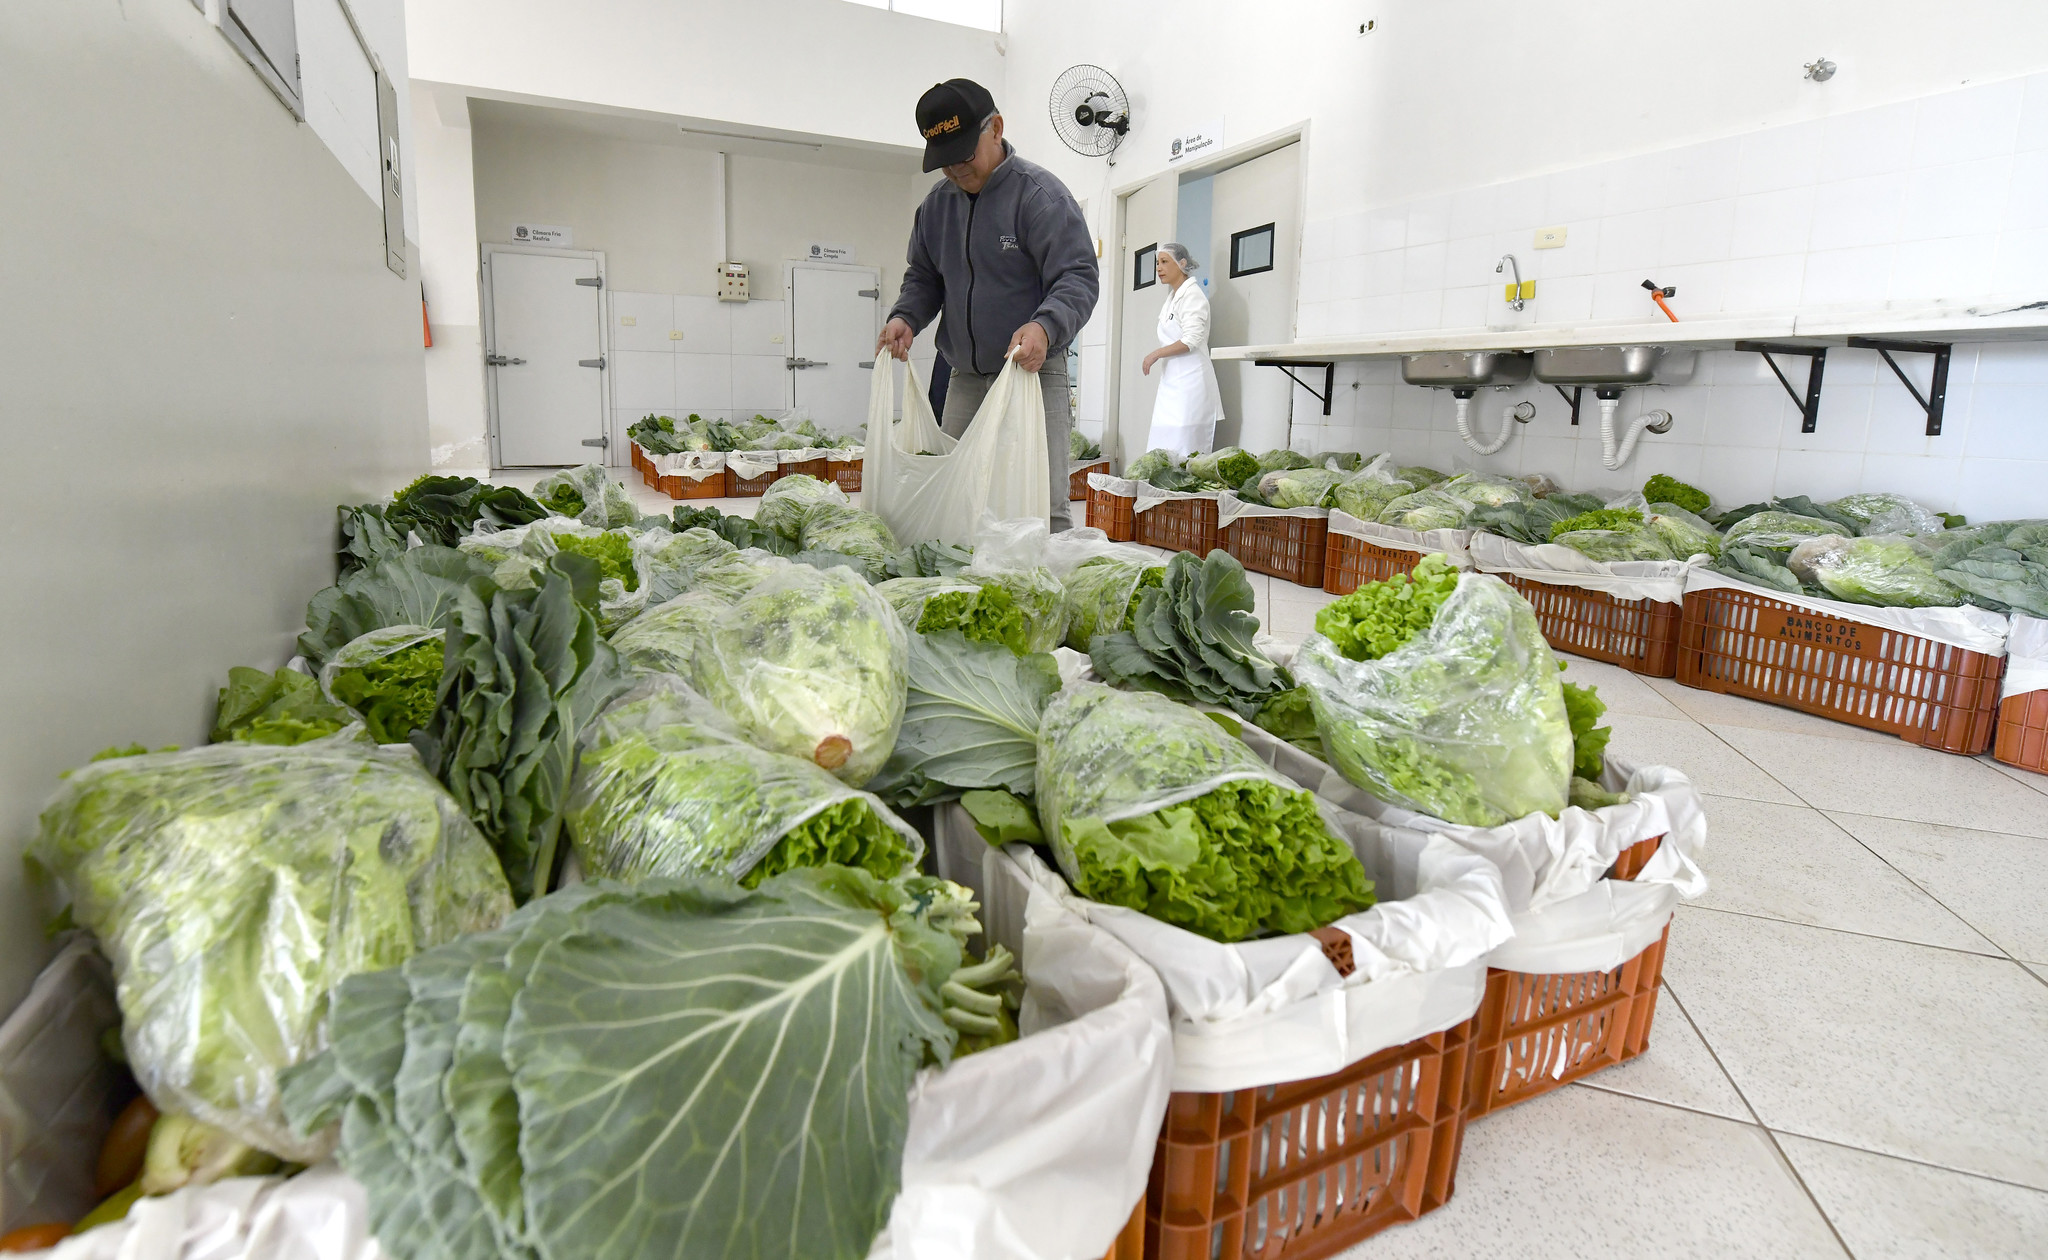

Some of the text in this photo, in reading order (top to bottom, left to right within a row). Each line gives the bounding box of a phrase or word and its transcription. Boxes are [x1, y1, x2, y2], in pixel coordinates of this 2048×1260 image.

[1185, 136, 1196, 145] Área
[1185, 138, 1213, 154] Manipulação
[1368, 546, 1413, 562] ALIMENTOS
[1787, 616, 1857, 637] BANCO DE
[1780, 626, 1861, 650] ALIMENTOS
